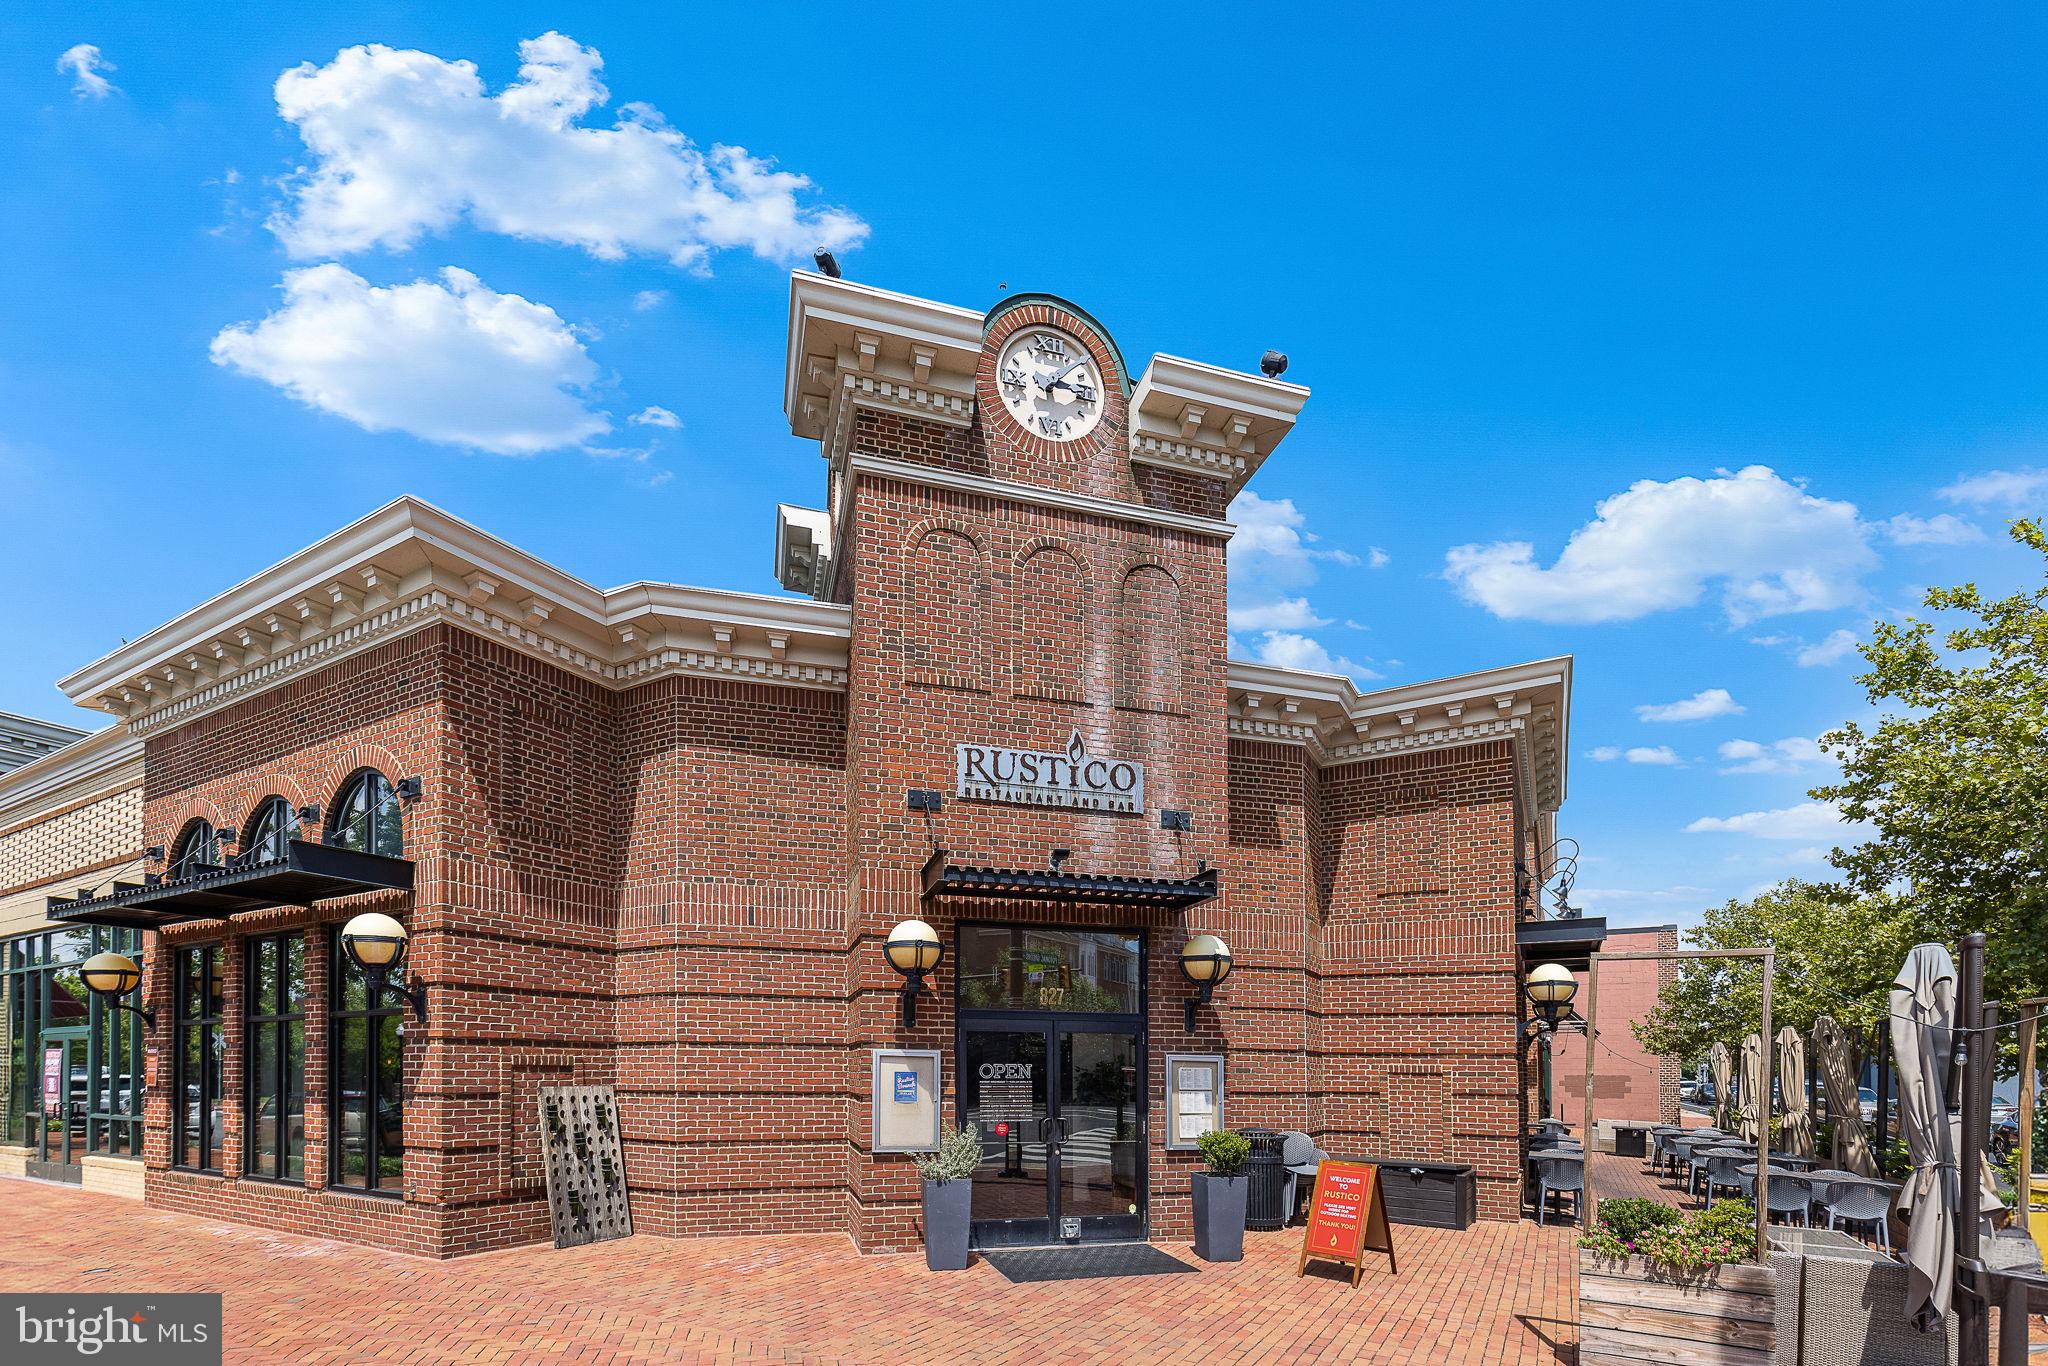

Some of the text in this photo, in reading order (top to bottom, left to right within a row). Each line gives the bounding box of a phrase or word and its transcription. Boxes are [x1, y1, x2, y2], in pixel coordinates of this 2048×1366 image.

[965, 787, 1134, 812] RESTAURANT AND BAR
[1040, 987, 1064, 1005] 827
[979, 1063, 1032, 1079] OPEN
[1329, 1175, 1360, 1185] WELCOME
[1324, 1190, 1360, 1201] RUSTICO
[1319, 1219, 1355, 1230] THANK YOU!
